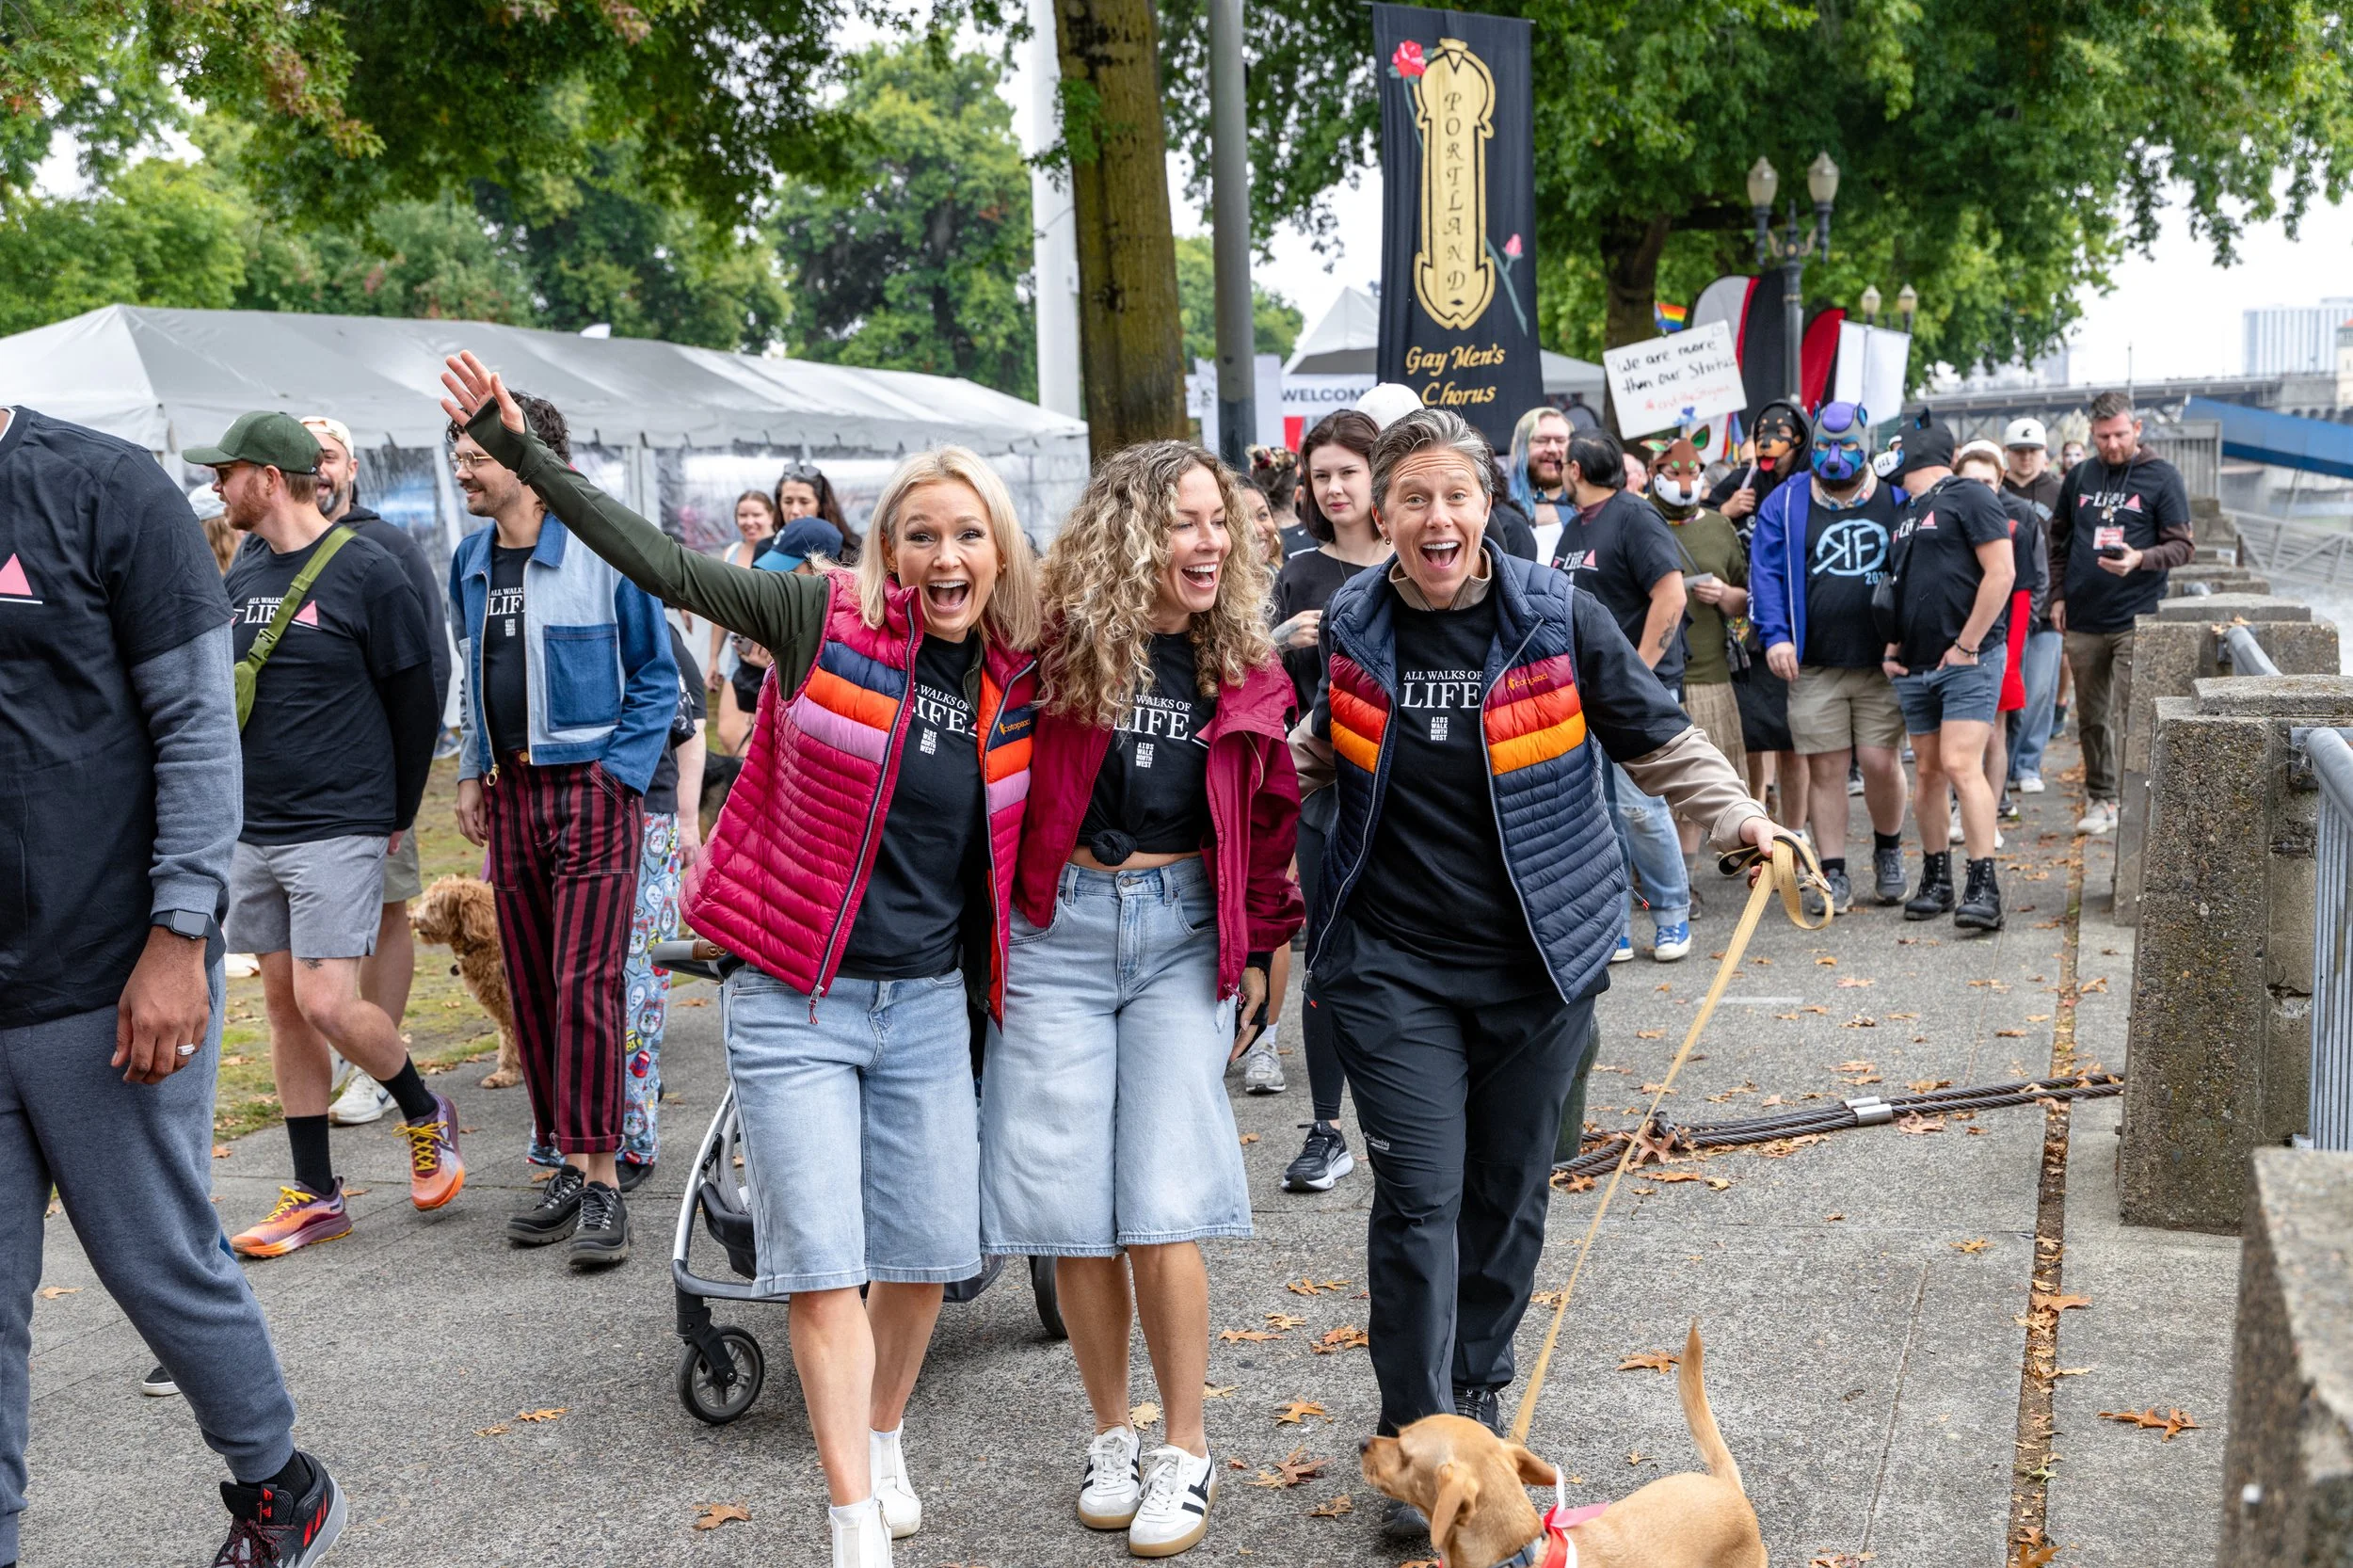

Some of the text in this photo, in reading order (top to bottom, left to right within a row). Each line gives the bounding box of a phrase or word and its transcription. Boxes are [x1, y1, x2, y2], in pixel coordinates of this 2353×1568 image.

[1443, 92, 1465, 291] PORTLAND
[1405, 343, 1506, 376] Gay Men's
[1617, 339, 1717, 375] We are more
[1658, 370, 1681, 385] our
[1281, 388, 1372, 402] WELCOM
[1421, 381, 1497, 406] Chorus
[503, 586, 523, 595] WALK
[244, 605, 280, 623] LIF
[488, 595, 525, 616] LIF
[1403, 670, 1483, 680] ALL WALKS OF
[920, 684, 955, 705] WALKS
[1135, 695, 1175, 709] WALKS
[1176, 700, 1193, 712] OF
[1401, 682, 1482, 709] LIFE
[913, 695, 968, 734] IFE
[1136, 748, 1154, 757] WALK
